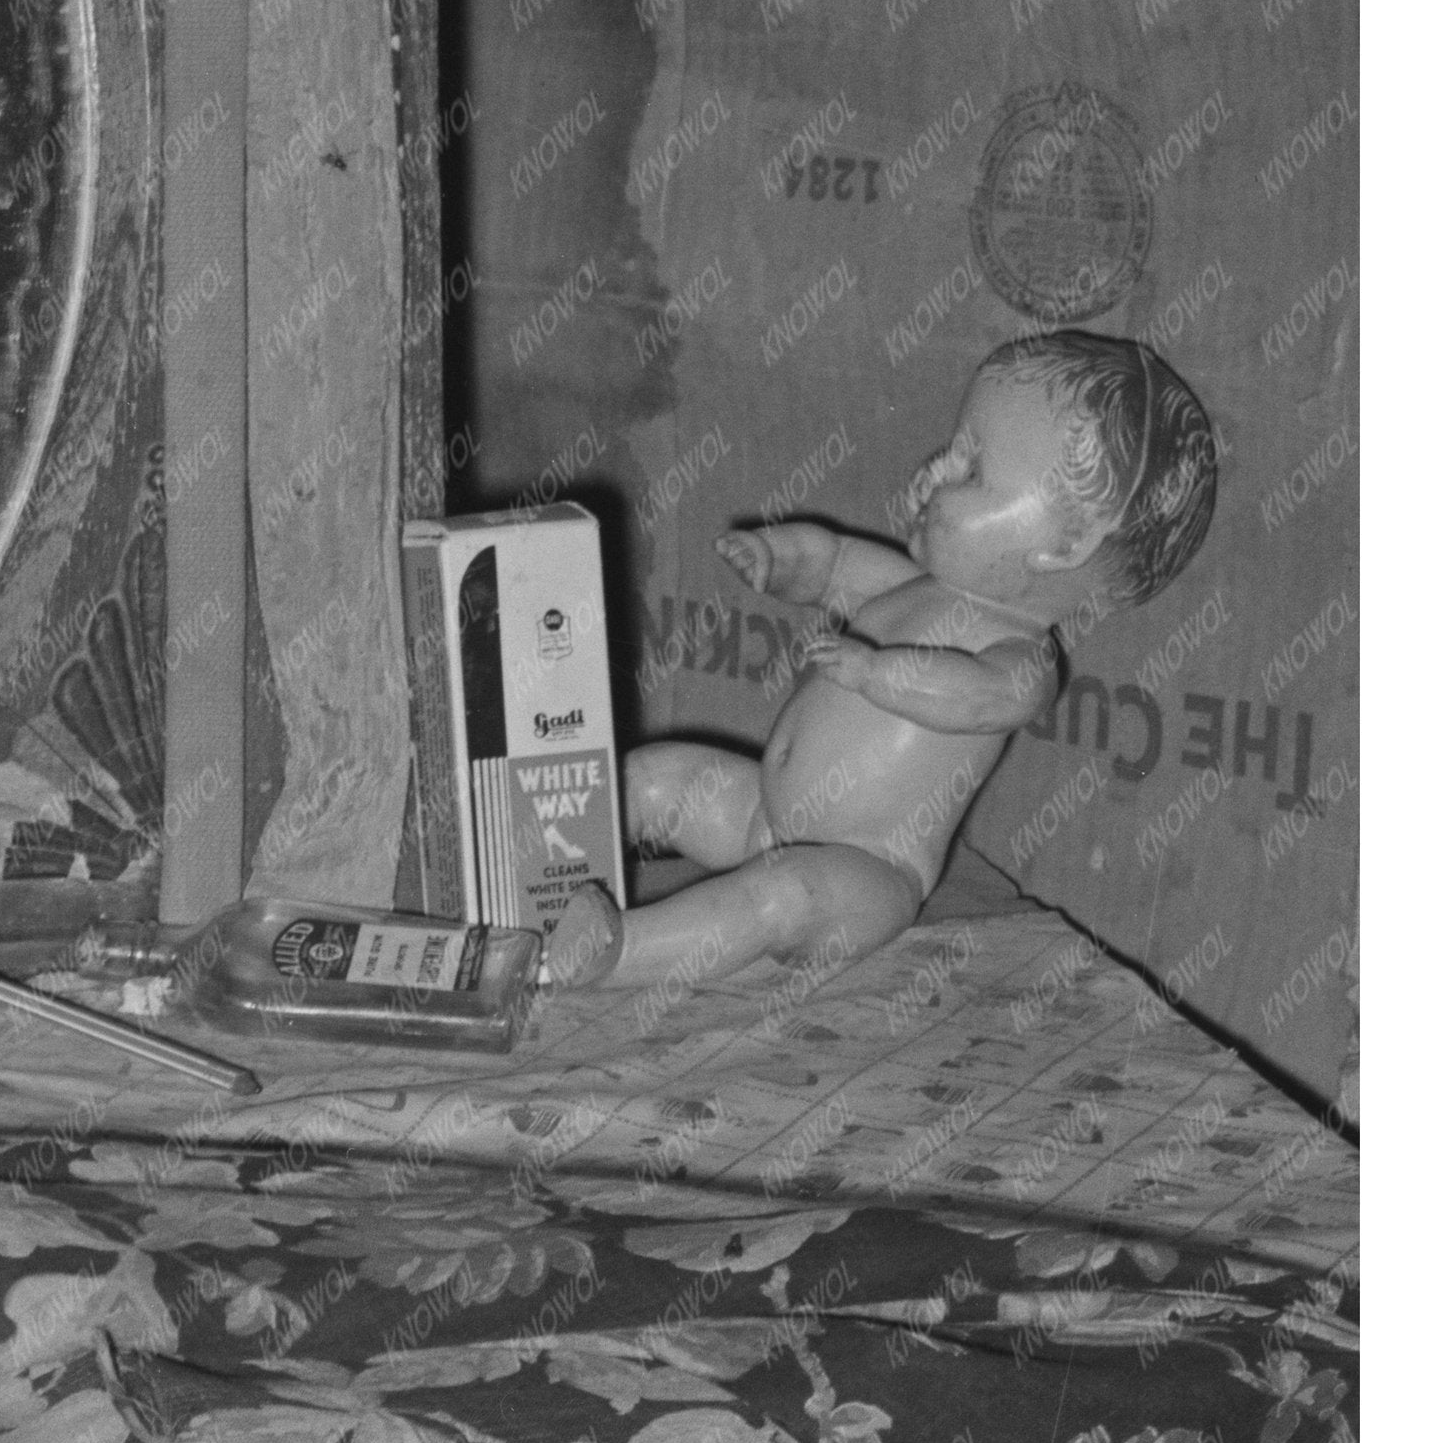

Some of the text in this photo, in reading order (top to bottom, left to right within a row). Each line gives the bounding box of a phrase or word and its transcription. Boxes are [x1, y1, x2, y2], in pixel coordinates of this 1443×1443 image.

[1180, 691, 1324, 819] THE
[516, 760, 601, 793] WHITE
[532, 790, 592, 821] WAY
[543, 863, 591, 879] CLEANS
[526, 881, 565, 896] WHITE
